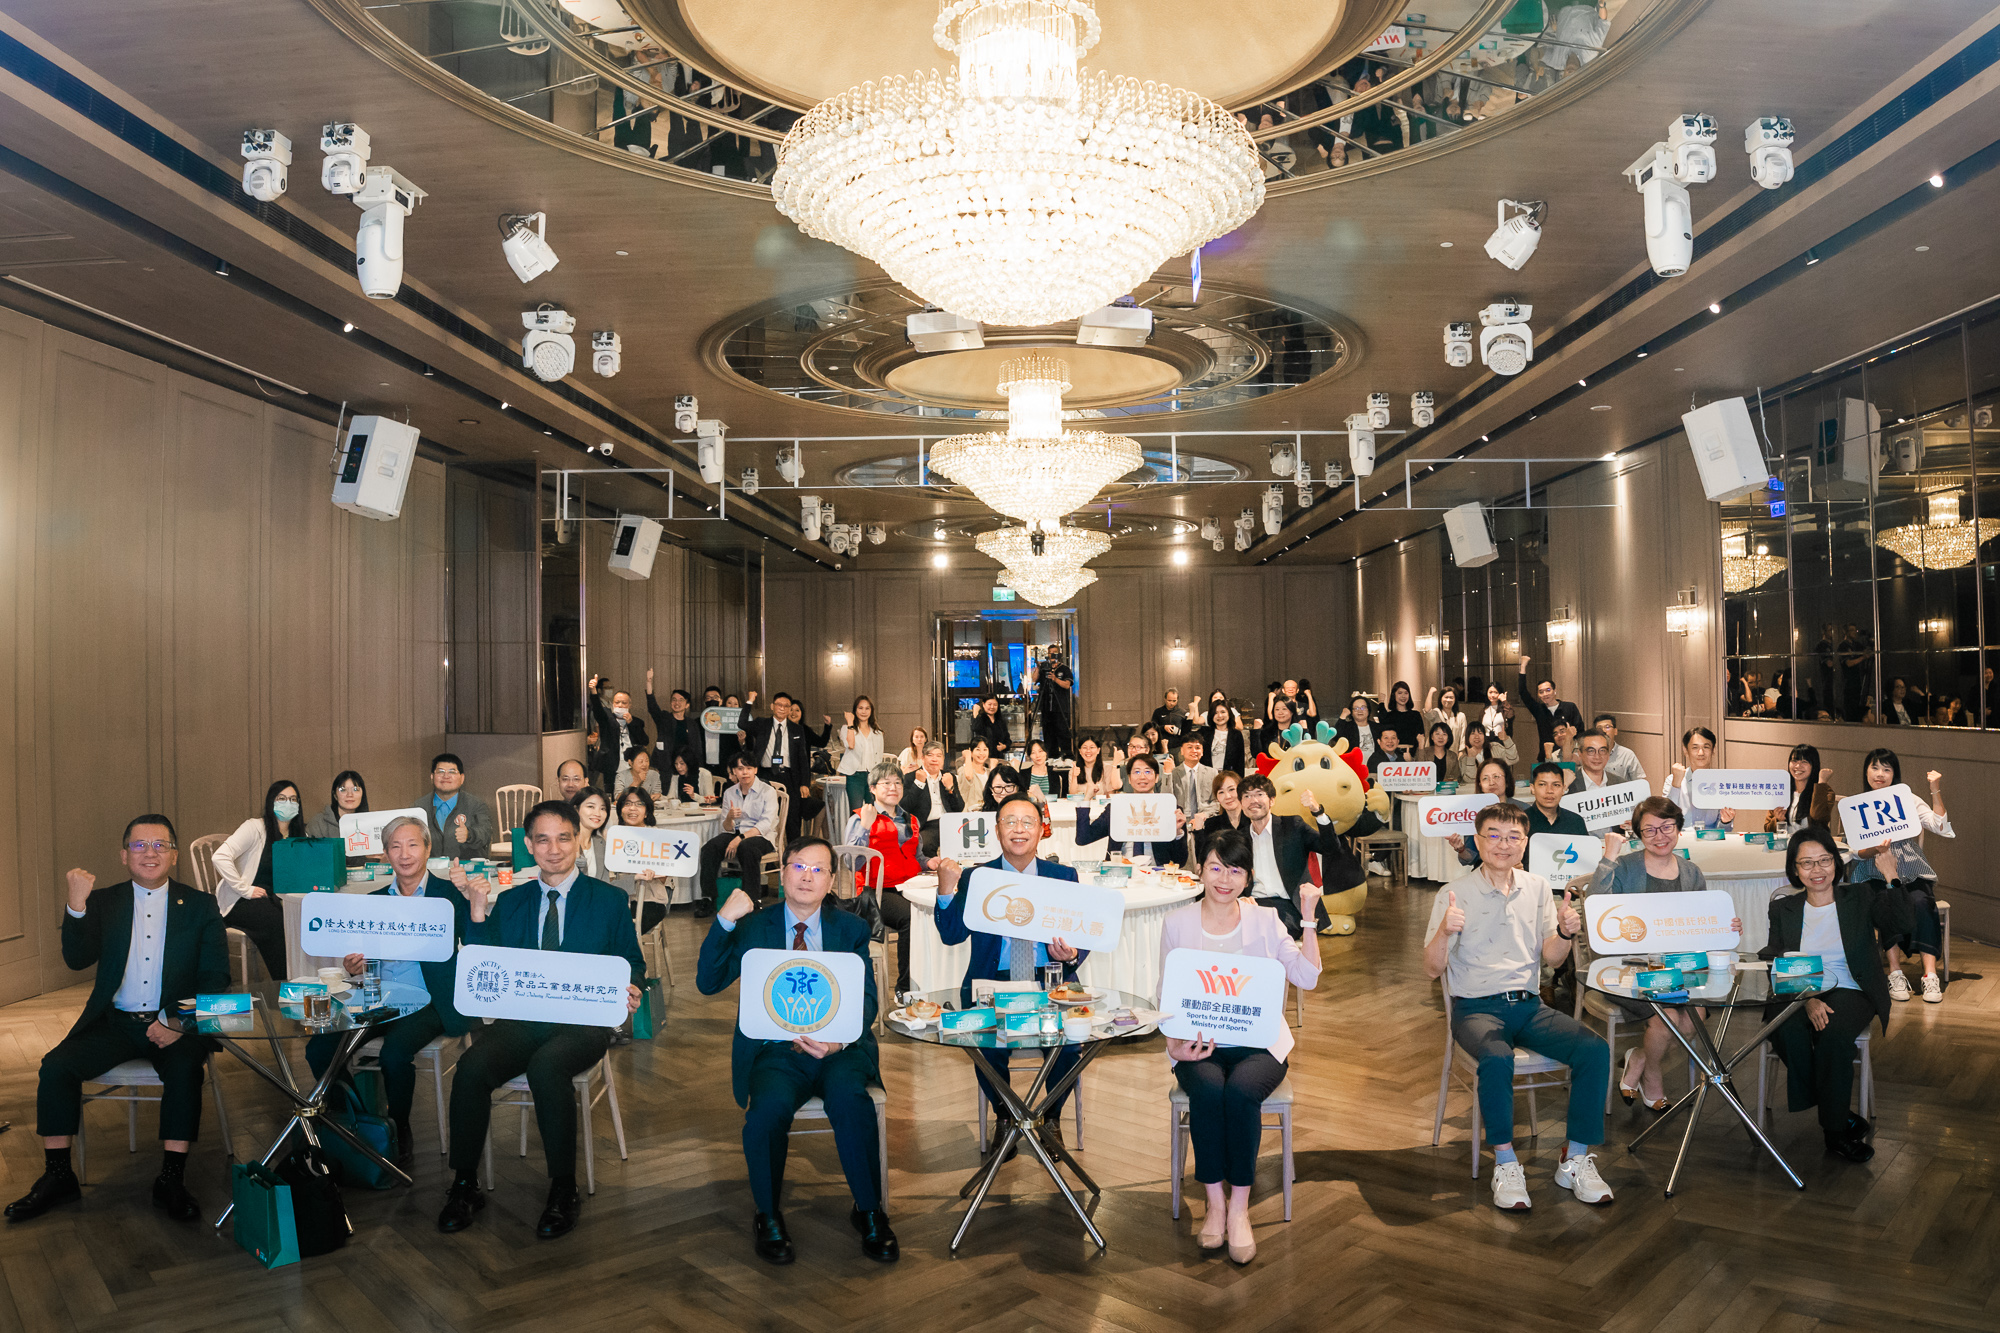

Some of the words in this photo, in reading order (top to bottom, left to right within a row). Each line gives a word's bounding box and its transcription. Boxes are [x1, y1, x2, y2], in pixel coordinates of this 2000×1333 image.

[1383, 766, 1431, 777] CALIN
[1719, 782, 1785, 790] 全智科技股份有限公司
[1577, 791, 1634, 813] FUJIFILM
[1426, 807, 1478, 825] Corete
[1583, 806, 1636, 822] 士軟片資訊股份有限
[1849, 794, 1906, 830] TRI
[1859, 823, 1909, 840] innovation
[325, 918, 447, 934] 隆大營建事業股份有限公司
[1042, 914, 1104, 937] 台灣人壽
[1653, 916, 1719, 927] 中國信託投信
[1677, 927, 1730, 936] INVESTMENTS
[514, 970, 545, 979] 財團法人
[514, 979, 618, 996] 食品工業發展研究所
[1181, 998, 1262, 1017] 運動部全民運動署
[1186, 1012, 1208, 1020] Sports
[1228, 1016, 1254, 1026] Agency,
[1191, 1020, 1217, 1030] Ministry
[1225, 1024, 1248, 1032] Sports
